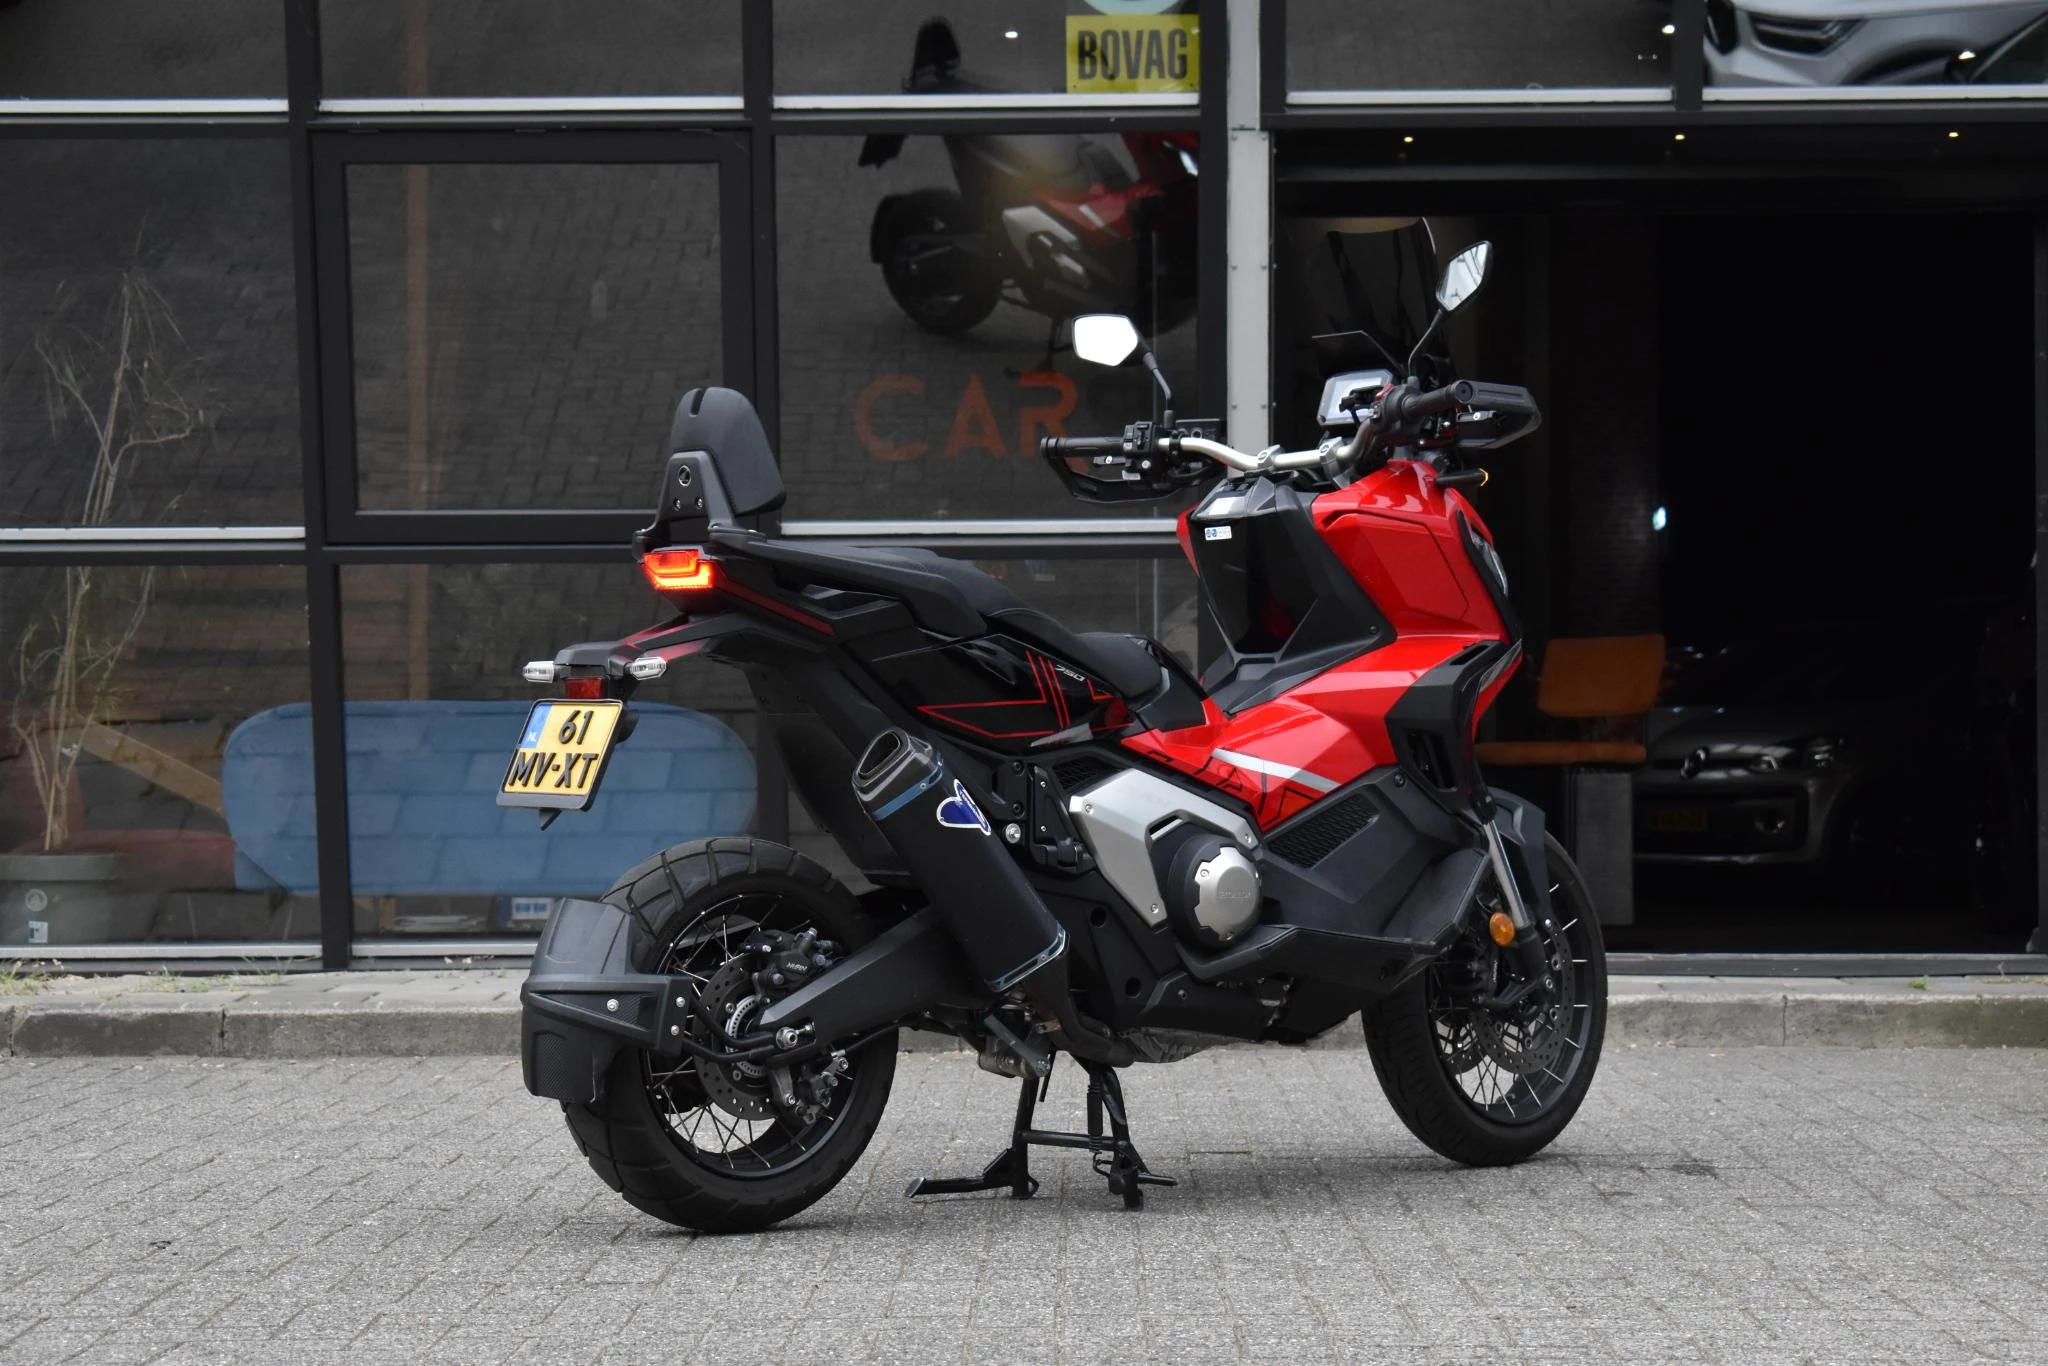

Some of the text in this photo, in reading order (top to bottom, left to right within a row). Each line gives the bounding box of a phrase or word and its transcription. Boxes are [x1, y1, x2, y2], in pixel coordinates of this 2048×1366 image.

[1078, 29, 1187, 80] BOVAG
[857, 371, 1089, 473] CAR
[558, 710, 594, 745] 61
[508, 751, 600, 789] MV-XT
